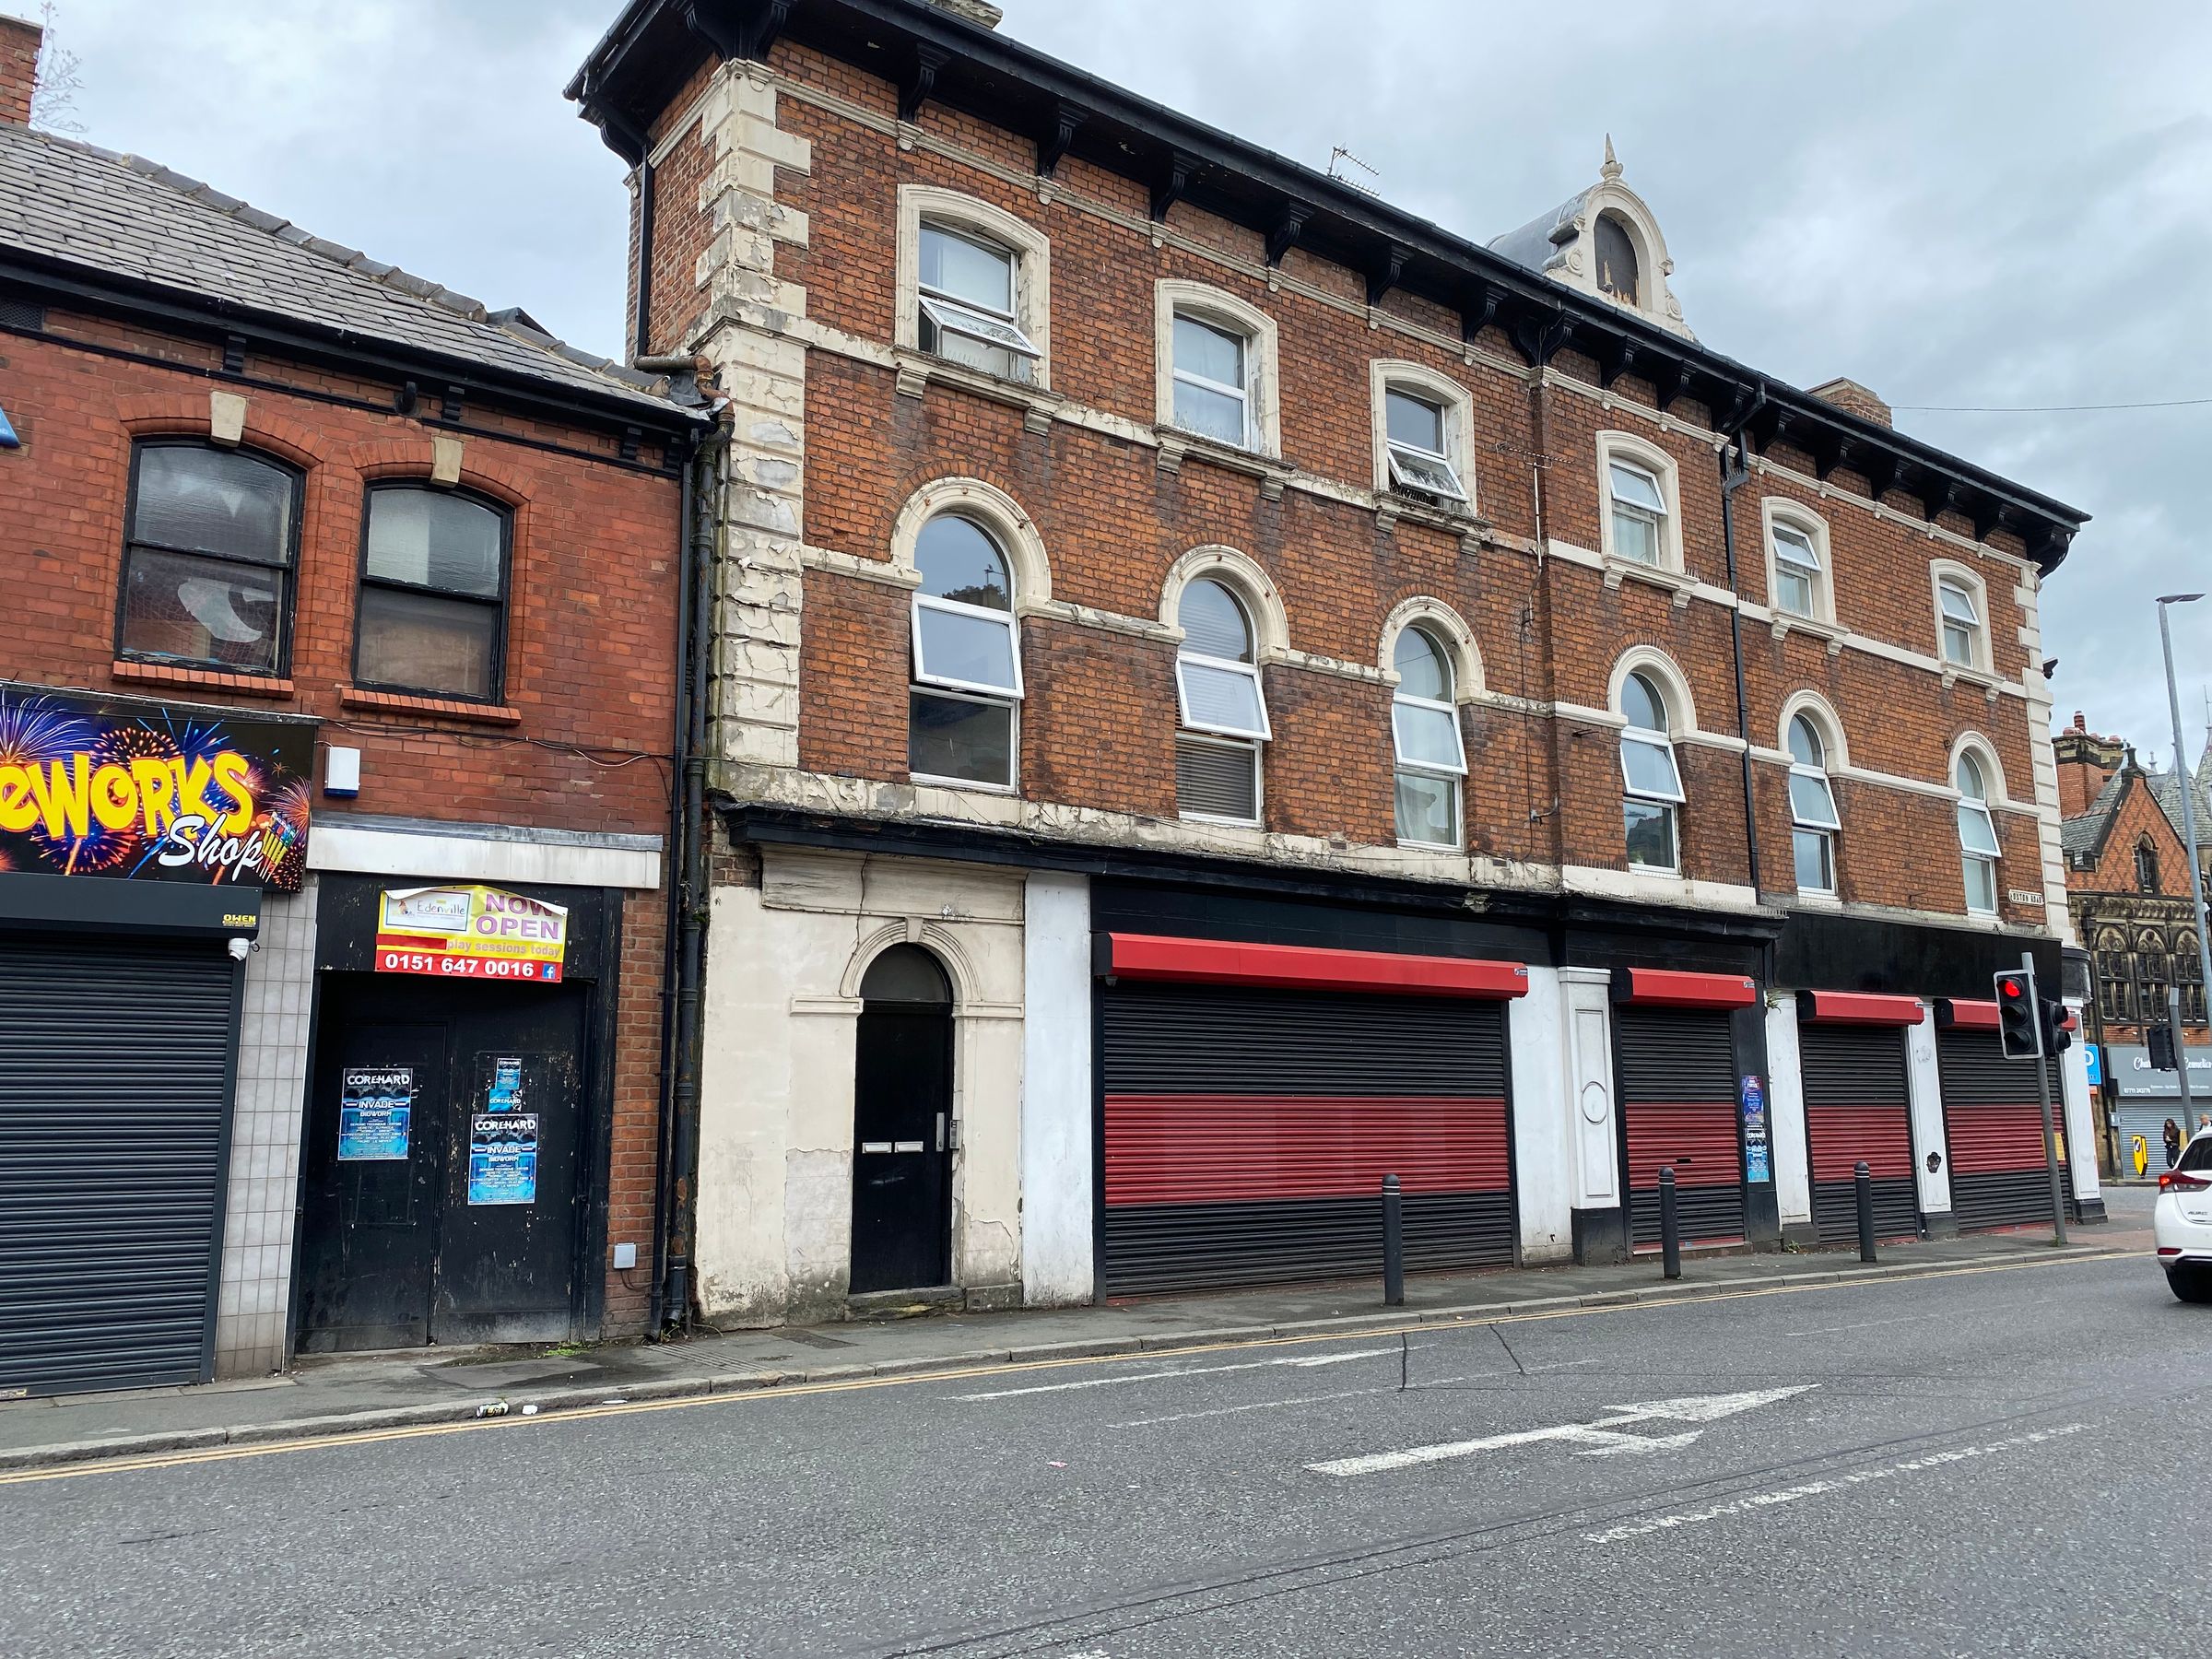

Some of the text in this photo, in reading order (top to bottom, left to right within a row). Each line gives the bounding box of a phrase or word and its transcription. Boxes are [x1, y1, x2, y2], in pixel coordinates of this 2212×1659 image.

[158, 812, 265, 882] Shop
[417, 900, 465, 915] Edenville
[485, 893, 553, 917] NOW
[223, 913, 256, 923] OWEN
[476, 915, 559, 940] OPEN
[447, 939, 560, 959] play sessions today
[385, 953, 535, 977] 0151 647 0016
[346, 1074, 410, 1086] COREHARD
[359, 1100, 394, 1109] INVADE
[475, 1119, 536, 1131] COREHARD
[487, 1145, 522, 1154] INVADE
